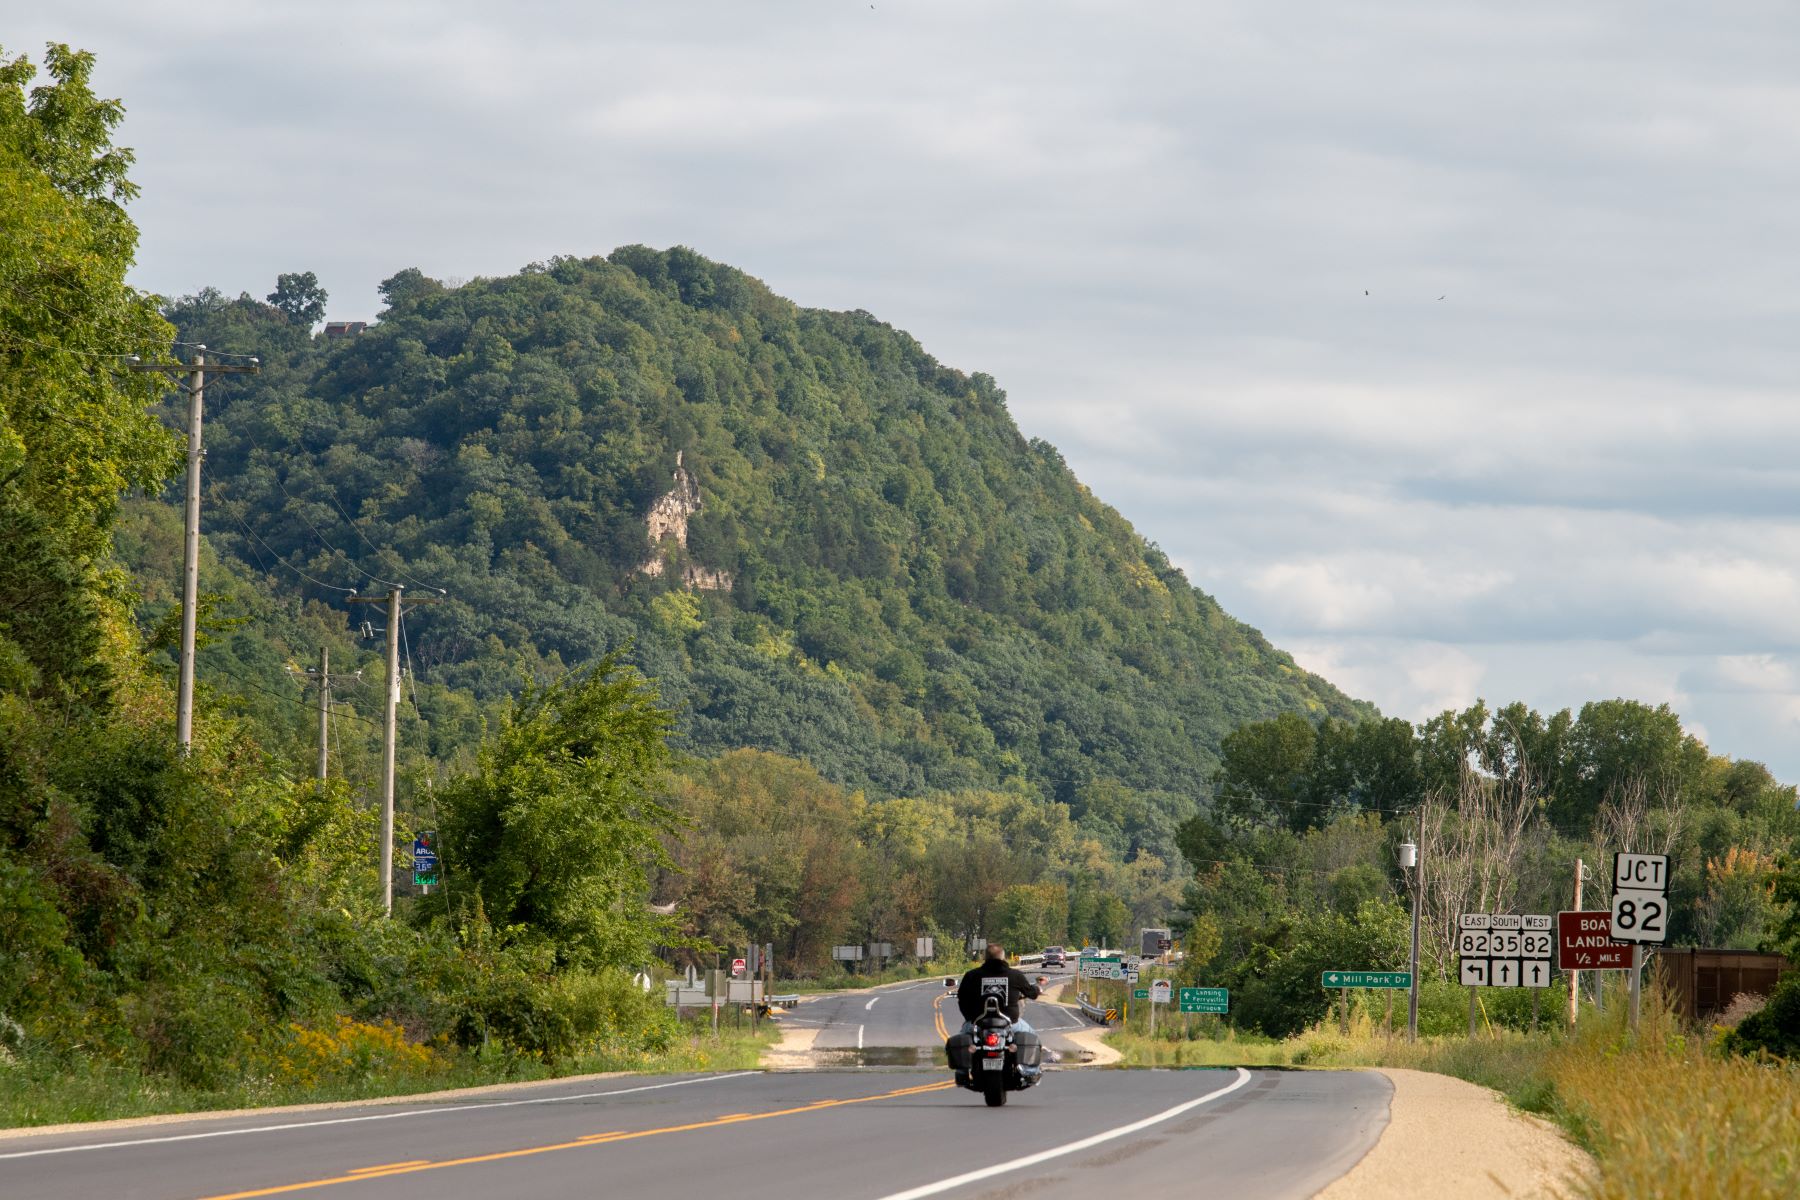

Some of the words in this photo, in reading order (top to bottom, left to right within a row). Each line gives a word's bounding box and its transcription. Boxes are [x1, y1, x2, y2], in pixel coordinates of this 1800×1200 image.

[1620, 860, 1663, 883] JCT
[1464, 916, 1487, 926] EAST
[1616, 900, 1662, 931] 82
[1492, 916, 1519, 927] SOUTH
[1525, 917, 1549, 927] WEST
[1462, 936, 1487, 952] 82
[1493, 936, 1518, 952] 35
[1524, 936, 1549, 953] 82
[1575, 953, 1591, 964] 1/2
[1599, 954, 1621, 962] MILE
[1128, 963, 1139, 971] 82
[1343, 975, 1362, 983] Mill
[1366, 975, 1390, 983] Park
[1395, 976, 1406, 984] Dr
